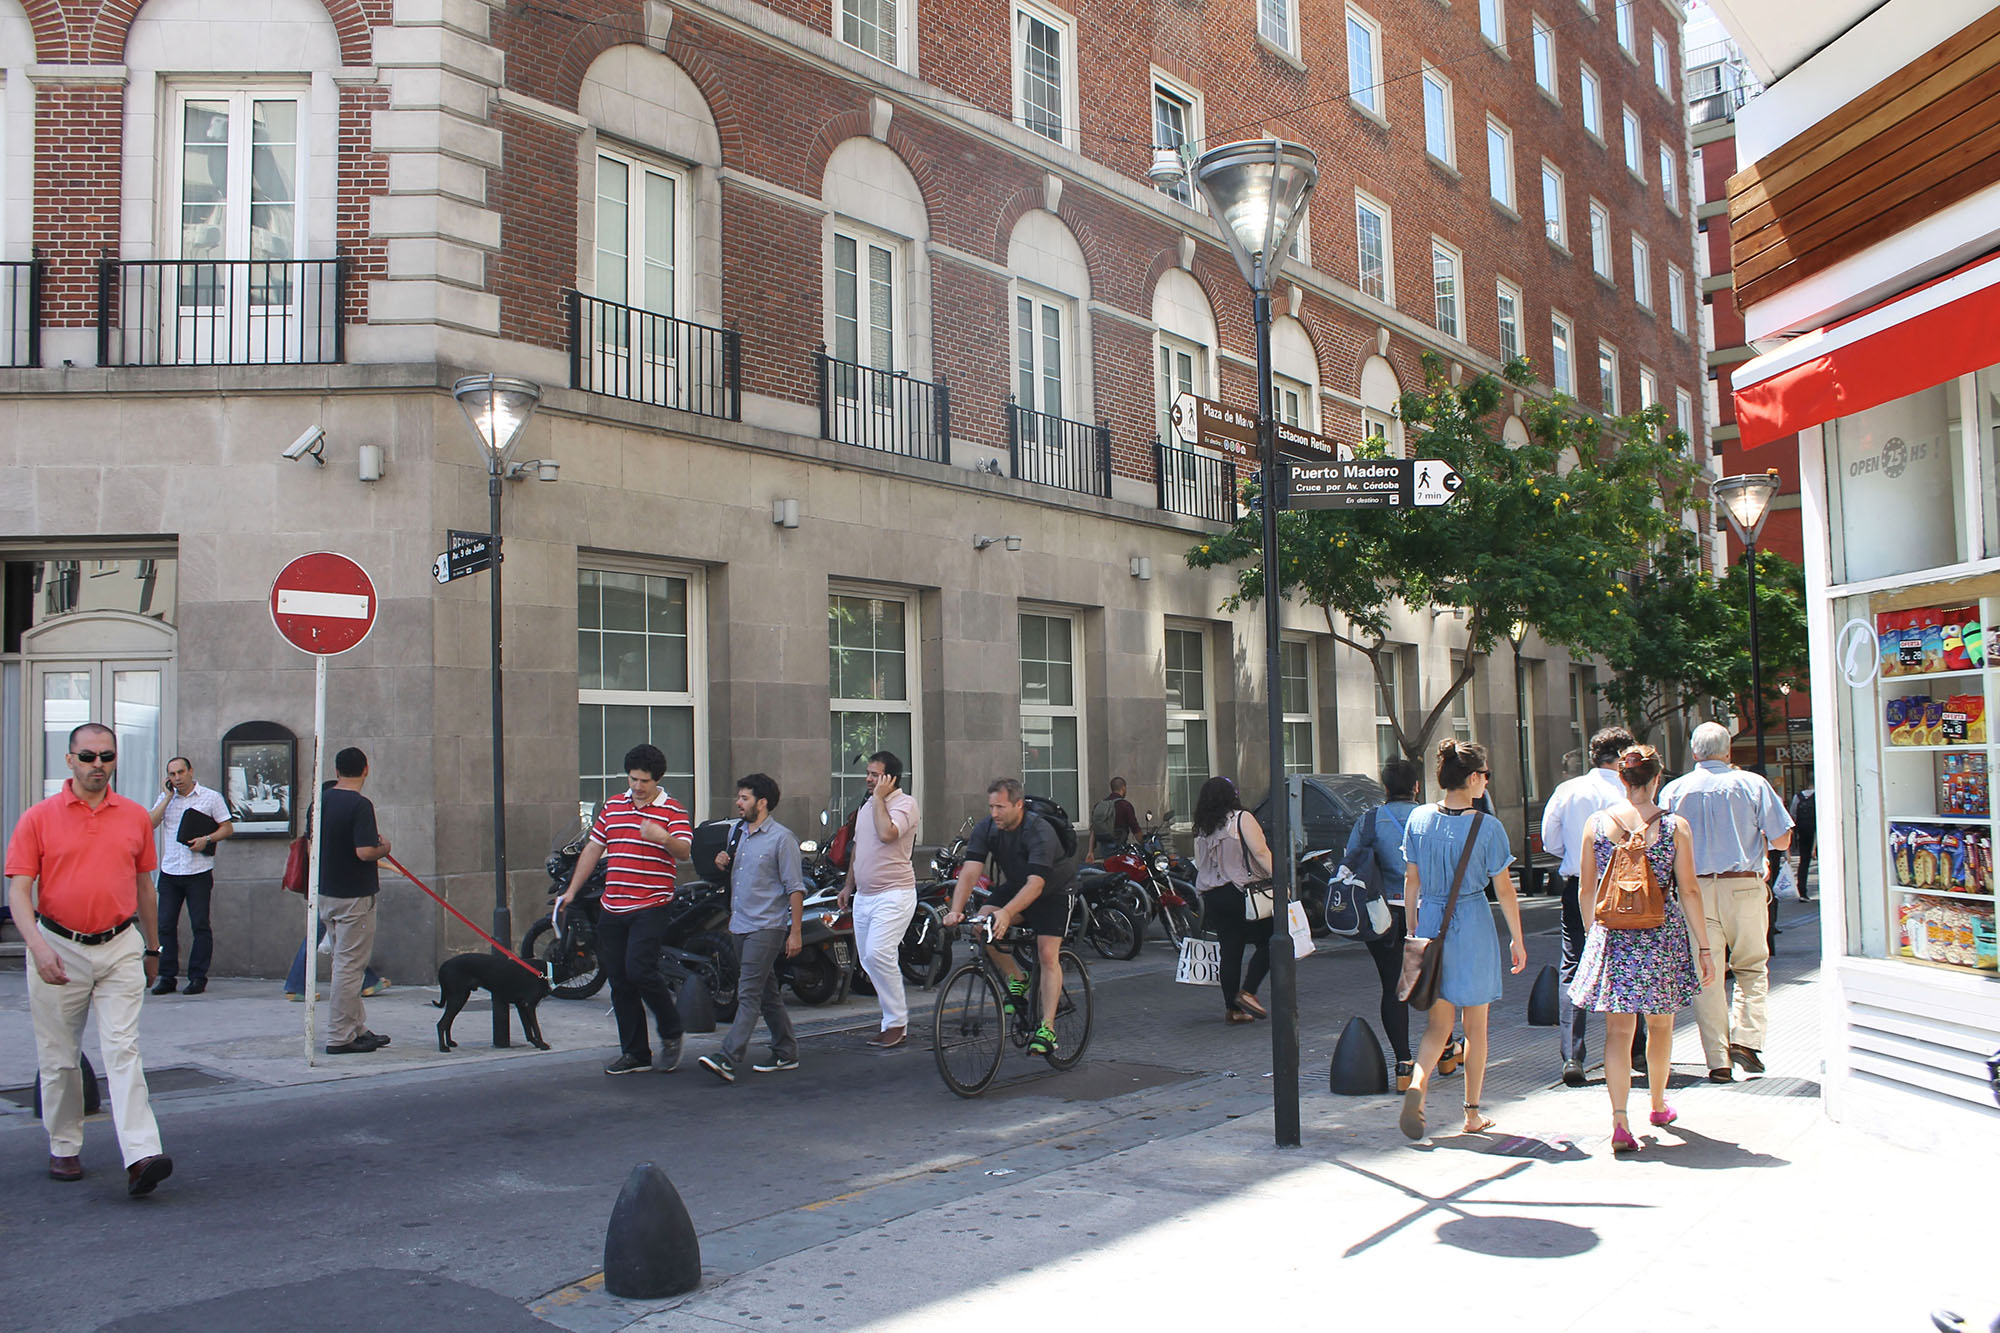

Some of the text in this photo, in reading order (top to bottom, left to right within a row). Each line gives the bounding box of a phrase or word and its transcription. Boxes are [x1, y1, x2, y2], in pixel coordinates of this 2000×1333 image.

[1203, 402, 1223, 421] Plaza
[1224, 410, 1234, 424] de
[1310, 435, 1332, 454] Retiro
[1291, 465, 1400, 480] Puerto Madero
[1850, 456, 1880, 477] OPEN
[1296, 480, 1400, 493] Cruce por Av. Córdoba
[1418, 492, 1442, 500] 7 min
[460, 549, 465, 558] 9
[465, 547, 472, 556] de
[473, 542, 486, 553] Julio
